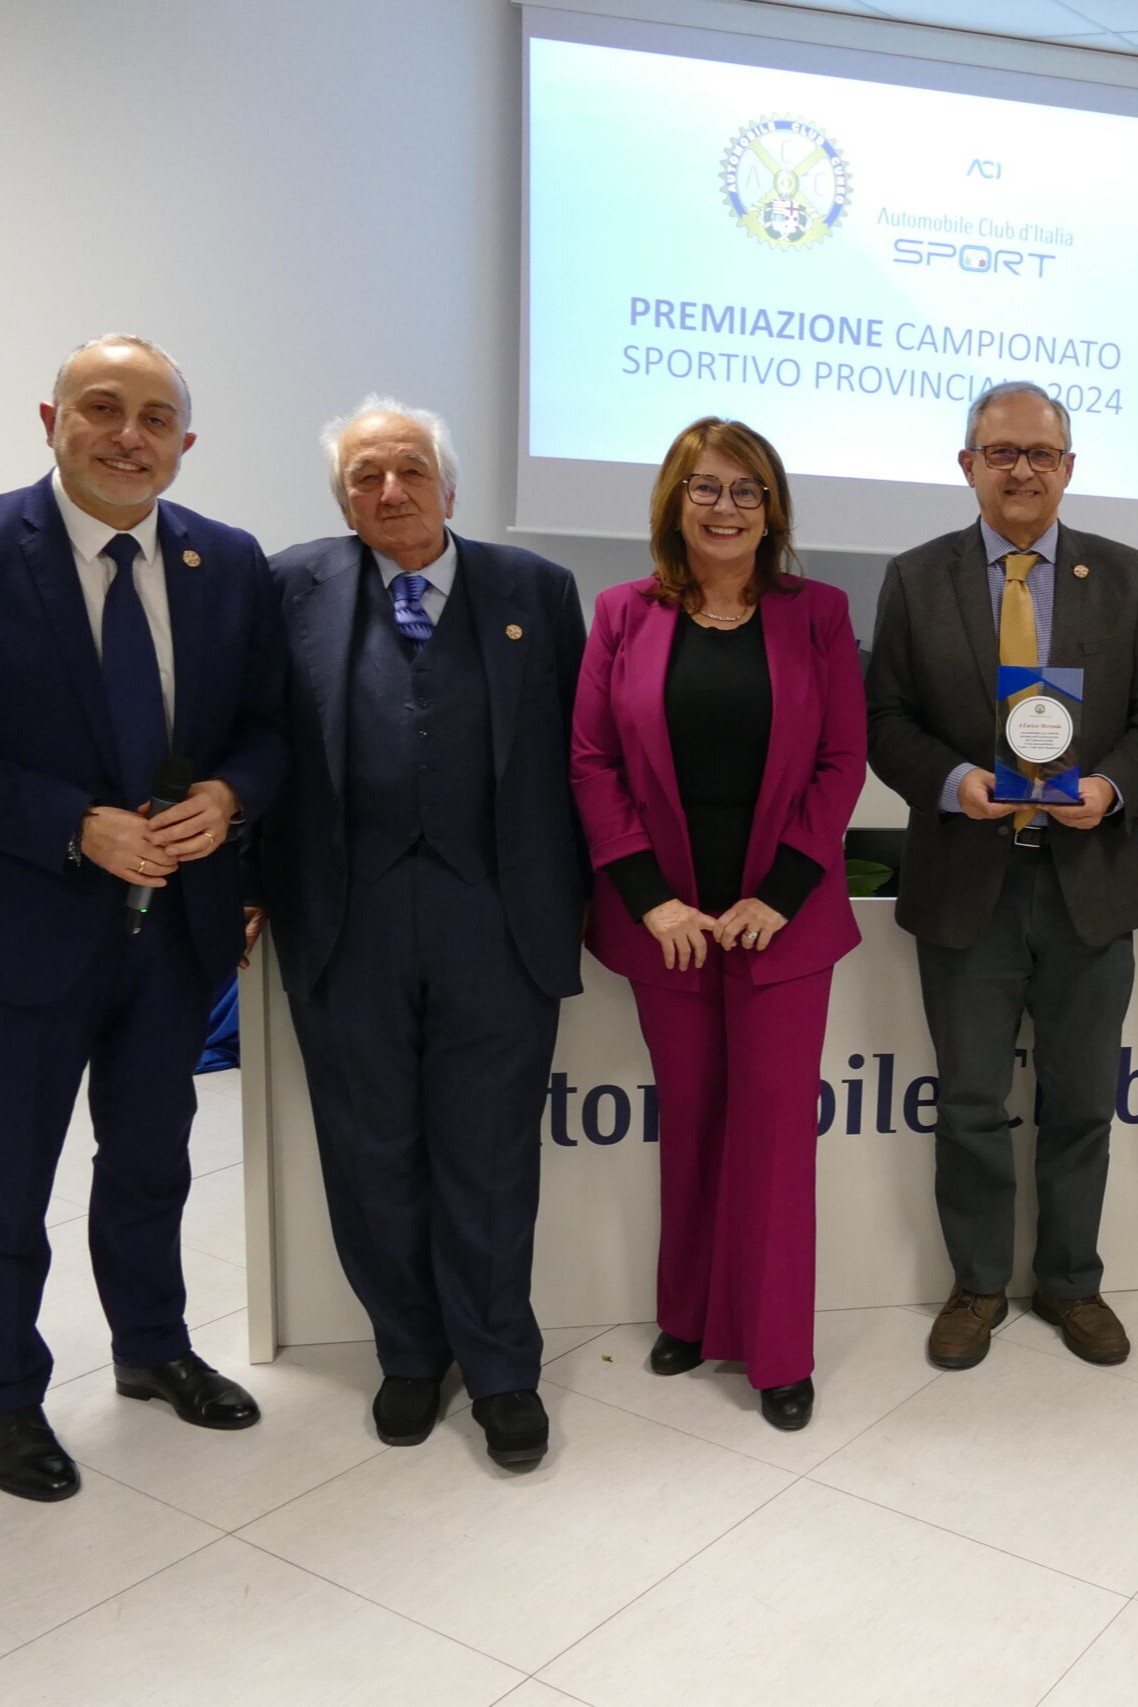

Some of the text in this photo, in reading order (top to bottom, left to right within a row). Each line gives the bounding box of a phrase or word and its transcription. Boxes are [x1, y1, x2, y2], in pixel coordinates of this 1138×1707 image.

[726, 121, 776, 192] AUTOMOBILE
[791, 122, 825, 145] CLUB
[966, 158, 1002, 180] ACI
[877, 206, 1074, 247] Automobile Club d'Italia
[893, 238, 1057, 278] SPORT
[630, 296, 1122, 370] PREMIAZIONE CAMPIONATO
[622, 345, 1123, 416] SPORTIVO PROVINCIA 2024
